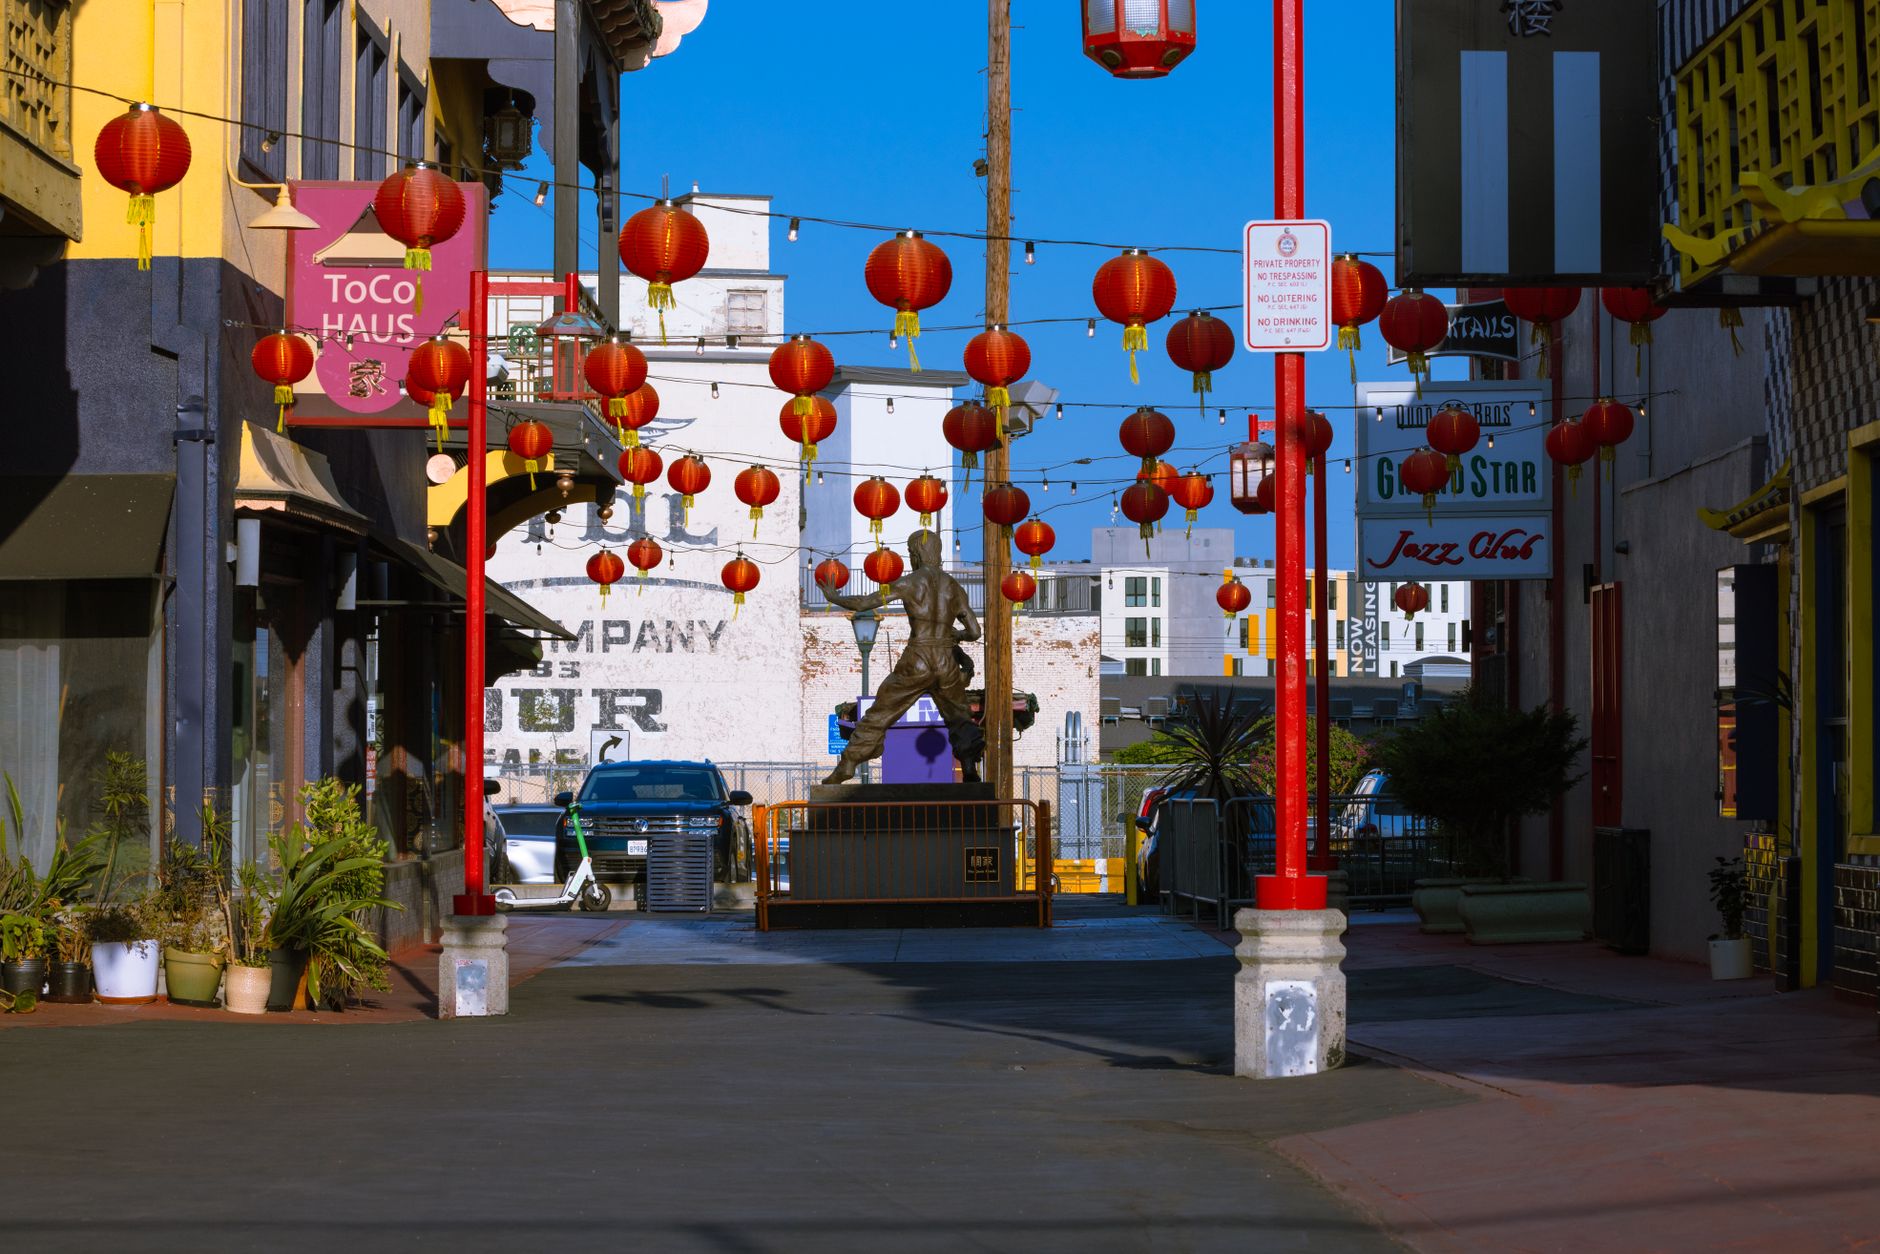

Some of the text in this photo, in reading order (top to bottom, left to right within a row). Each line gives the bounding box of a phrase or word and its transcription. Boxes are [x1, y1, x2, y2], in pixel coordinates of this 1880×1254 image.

[1253, 258, 1320, 268] PRIVATE PROPERTY
[1257, 271, 1317, 280] NO TRESPASSING
[323, 274, 415, 304] ToCo
[1257, 294, 1317, 303] NO LOITERING
[322, 314, 414, 343] HAUS
[1257, 317, 1317, 326] NO DRINKING
[1470, 455, 1536, 498] STAR
[1366, 528, 1544, 569] Jazz Club
[1365, 582, 1376, 673] LEASING
[1351, 616, 1363, 673] NOW
